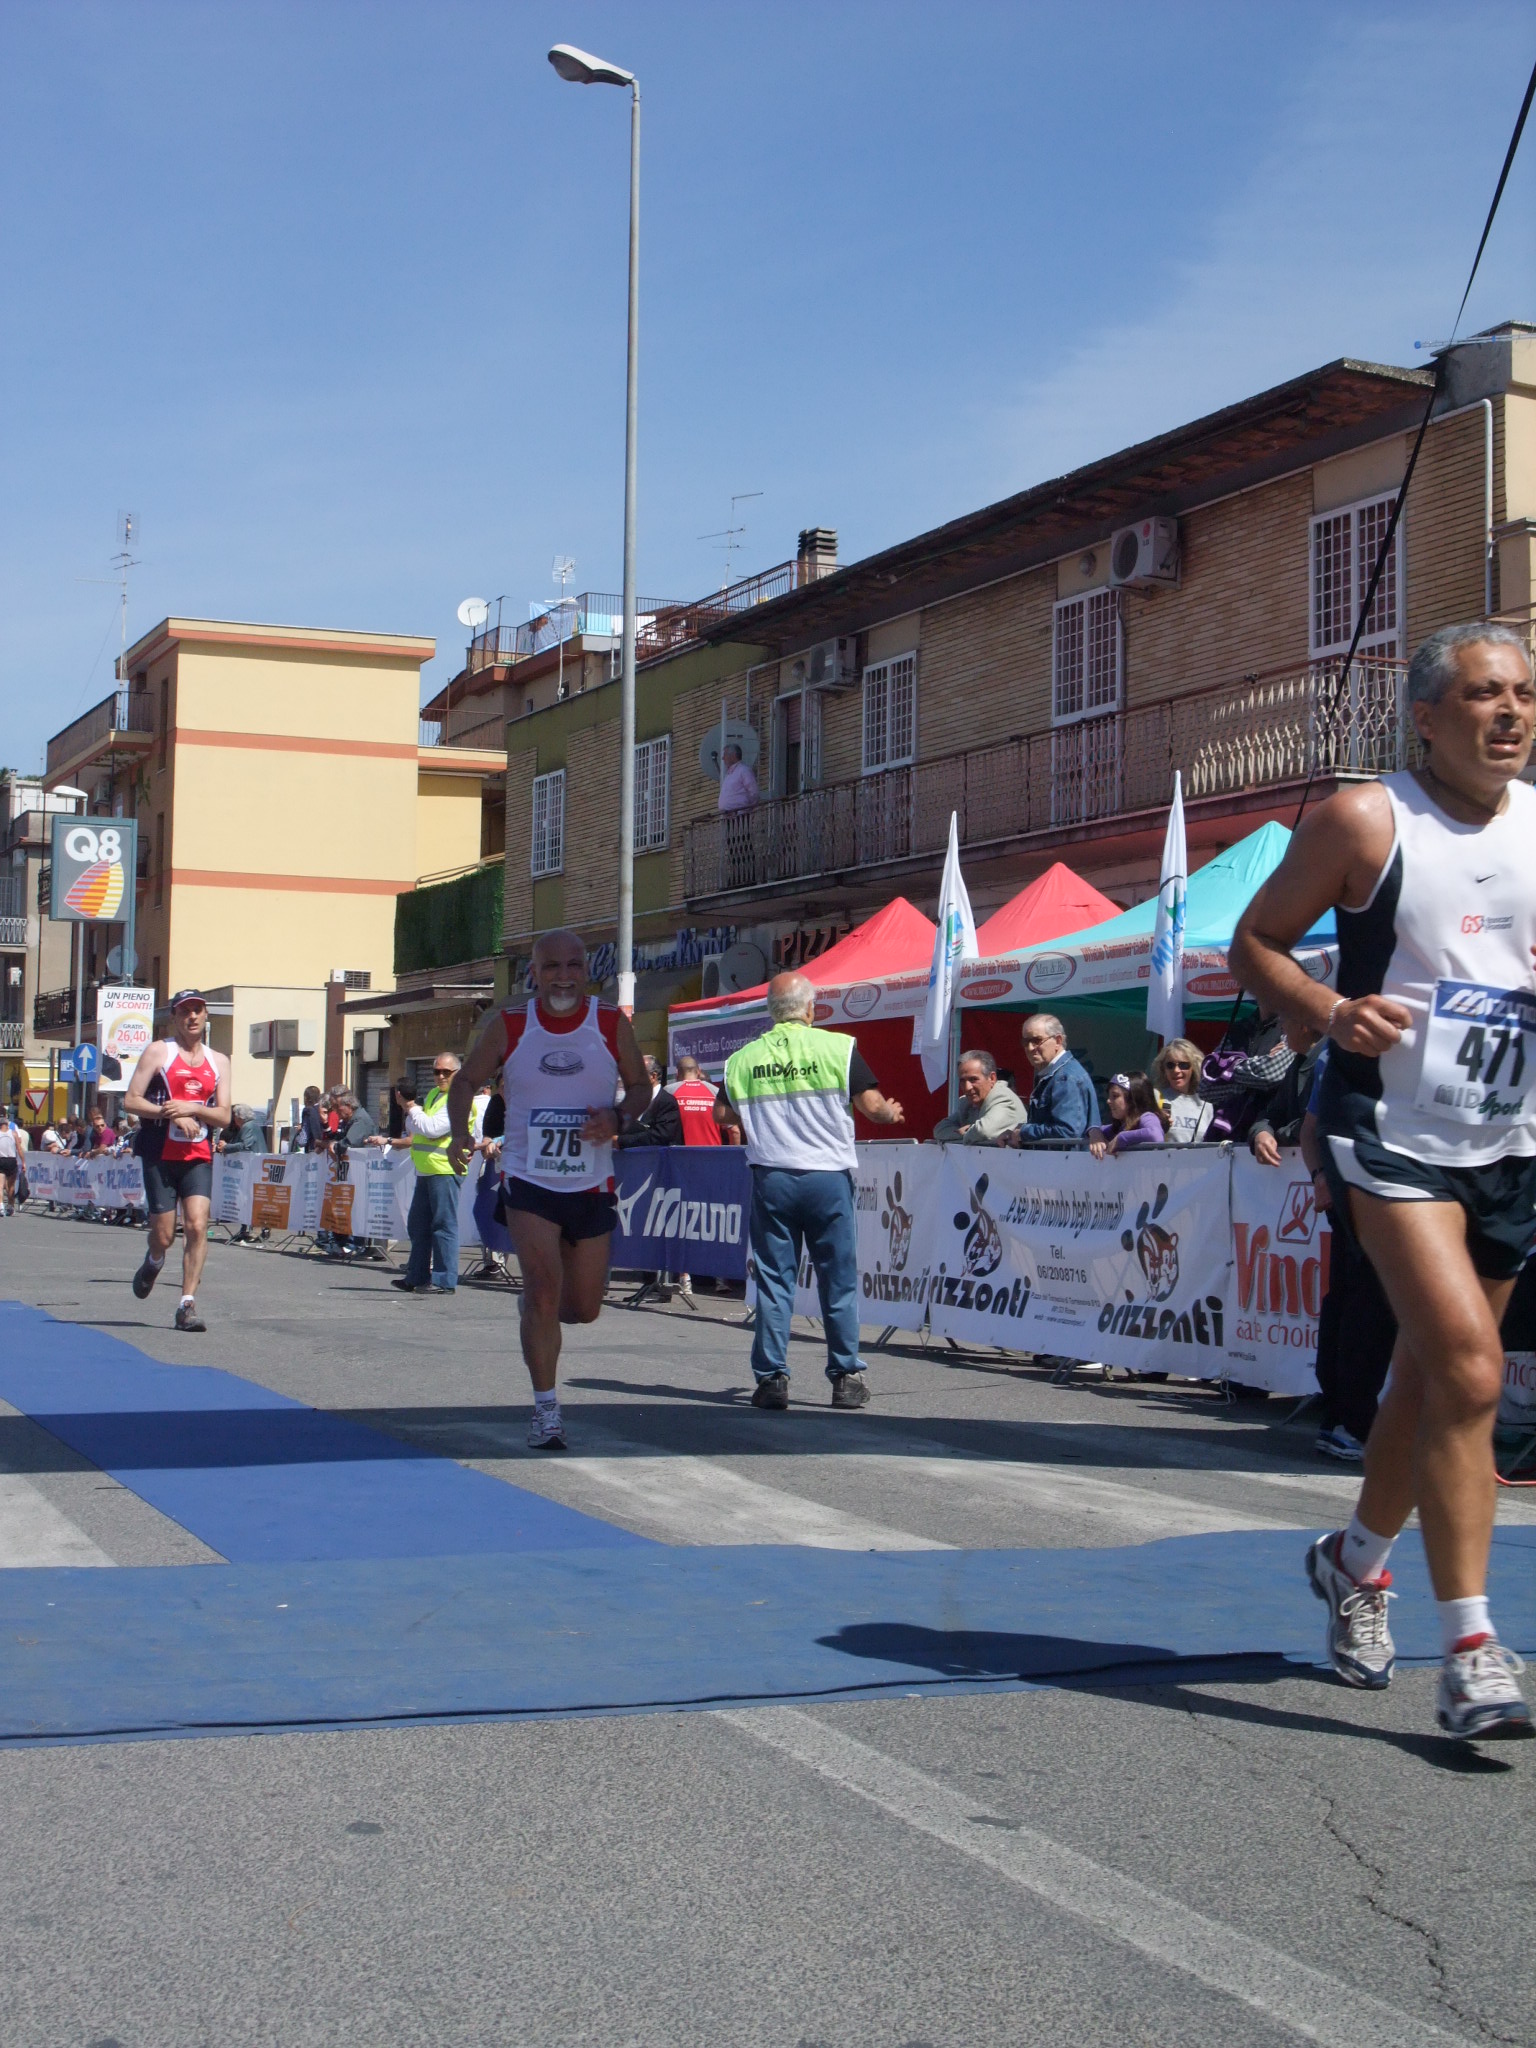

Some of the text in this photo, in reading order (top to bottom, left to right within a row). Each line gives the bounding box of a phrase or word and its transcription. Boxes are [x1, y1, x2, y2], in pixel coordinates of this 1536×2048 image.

[65, 827, 122, 863] Q8
[781, 922, 863, 966] PIZZE
[107, 992, 150, 1001] UN PIENO
[1456, 1026, 1526, 1087] 471
[540, 1128, 583, 1158] 276
[1013, 1188, 1029, 1225] sei
[1026, 1188, 1042, 1226] nel
[1040, 1190, 1071, 1228] mondo
[1070, 1190, 1092, 1239] degli
[1090, 1191, 1124, 1231] animali
[1050, 1245, 1066, 1260] Tel.
[929, 1262, 1031, 1318] rizzonti
[1037, 1265, 1087, 1284] 06/2008716
[1097, 1289, 1223, 1347] orizzonti
